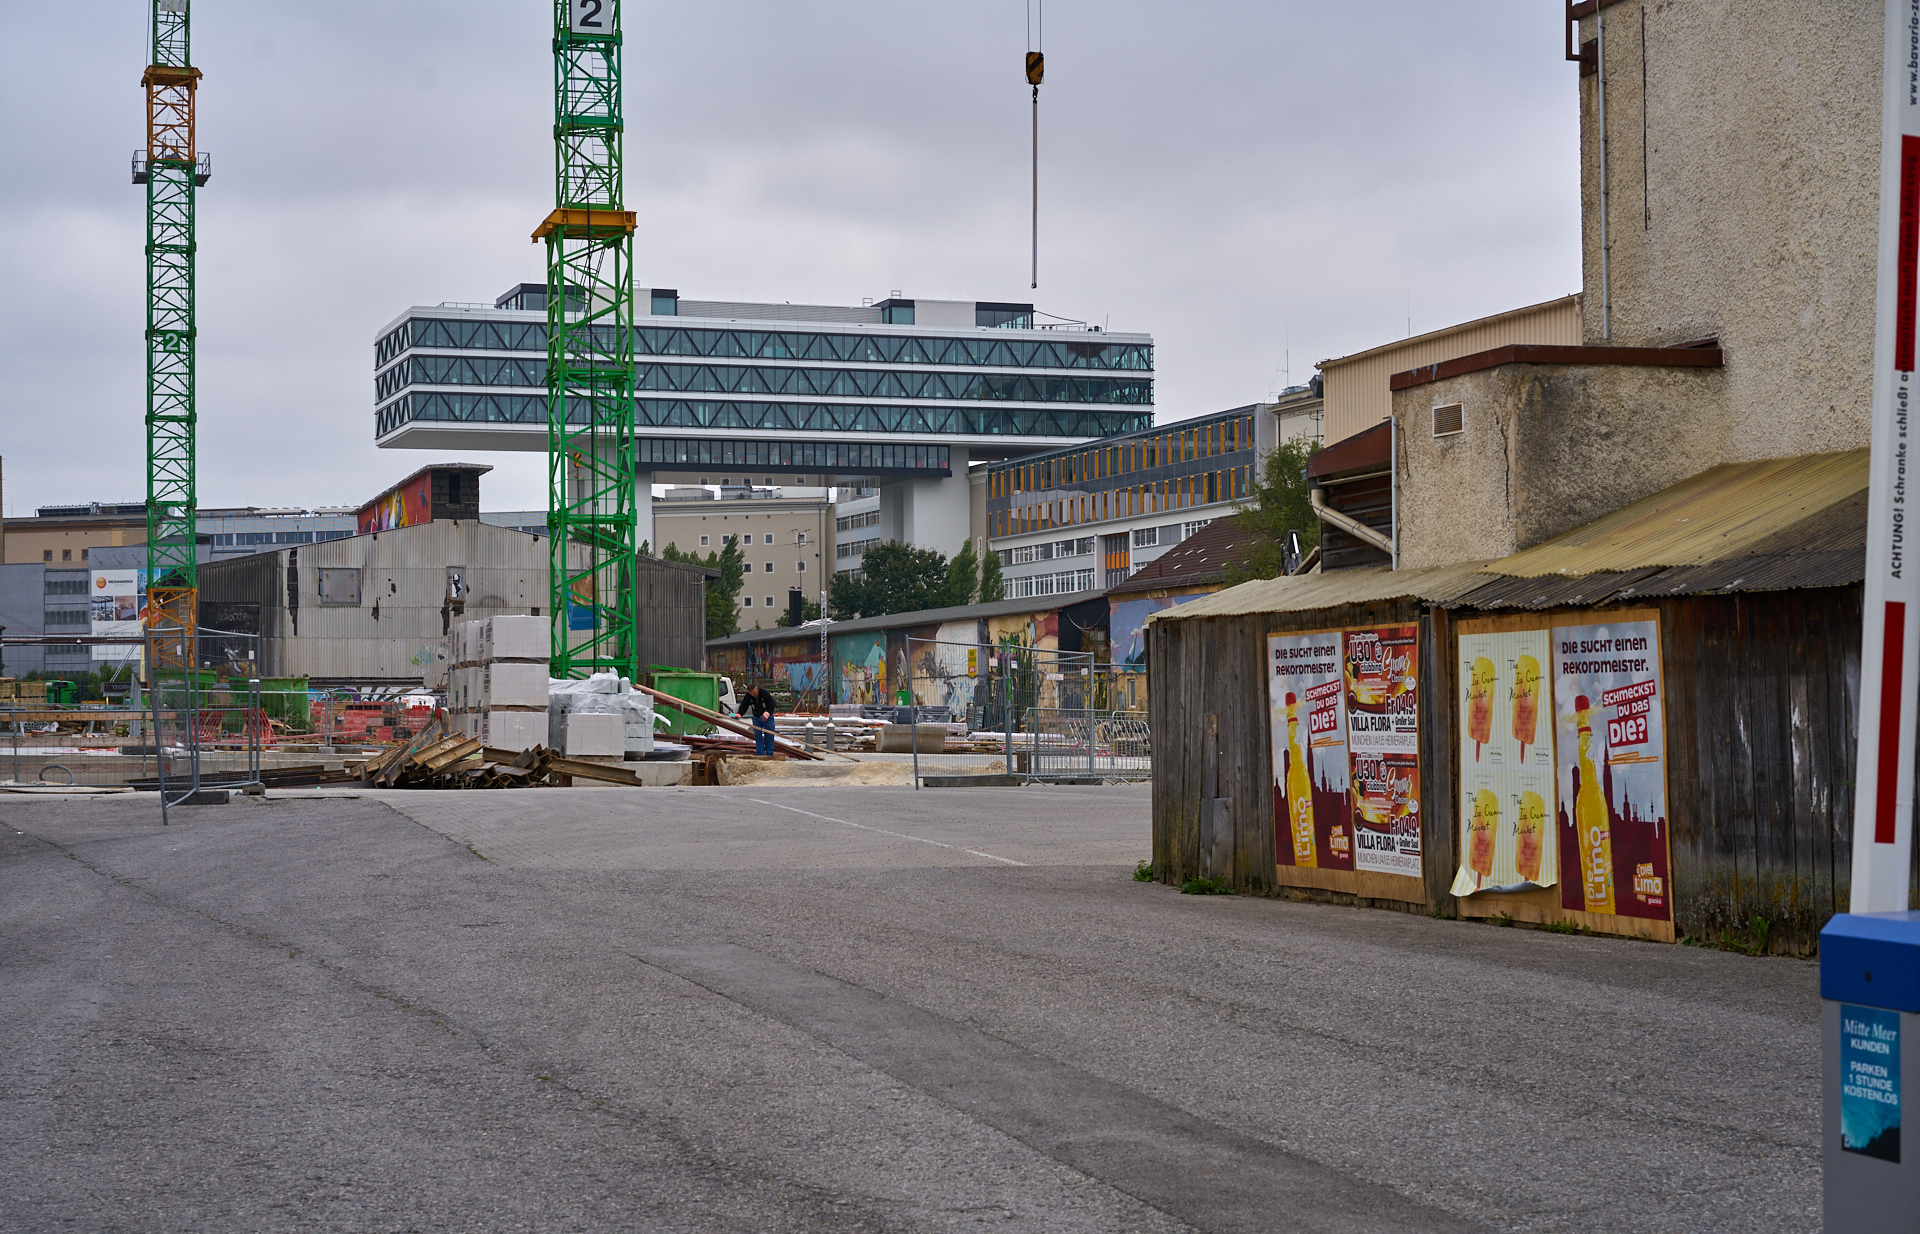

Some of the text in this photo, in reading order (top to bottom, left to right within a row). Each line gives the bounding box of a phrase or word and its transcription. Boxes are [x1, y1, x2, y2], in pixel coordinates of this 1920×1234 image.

[579, 0, 602, 27] 2
[165, 333, 178, 350] 2
[1891, 155, 1916, 579] ACHTUNG! Schranke schließt automatisch nach jedem Fahrzeug
[1290, 647, 1312, 658] SUCHT
[1580, 640, 1612, 653] SUCHT
[1464, 662, 1474, 672] The
[1508, 660, 1519, 671] The
[1471, 672, 1500, 686] Ice Cream
[1515, 670, 1545, 685] Ice Cream
[1465, 686, 1487, 702] Market
[1509, 685, 1532, 701] Market
[1316, 700, 1324, 710] DU
[1618, 704, 1629, 717] DU
[1351, 716, 1369, 731] VILLA
[1370, 716, 1391, 731] FLORA
[1351, 733, 1370, 745] MÜNCHEN
[1466, 792, 1477, 803] The
[1511, 794, 1523, 806] The
[1473, 804, 1503, 817] Ice Cream
[1519, 806, 1550, 820] Ice Cream
[1467, 819, 1490, 833] Market
[1513, 822, 1537, 836] Market
[1357, 834, 1375, 850] VILLA
[1376, 836, 1396, 852] FLORA
[1357, 851, 1377, 864] MÜNCHEN
[1844, 1019, 1897, 1041] Mitte Meer
[1851, 1038, 1889, 1054] KUNDEN
[1851, 1061, 1887, 1077] PARKEN
[1849, 1074, 1893, 1092] 1 STUNDE
[1844, 1085, 1898, 1105] KOSTENLOS
